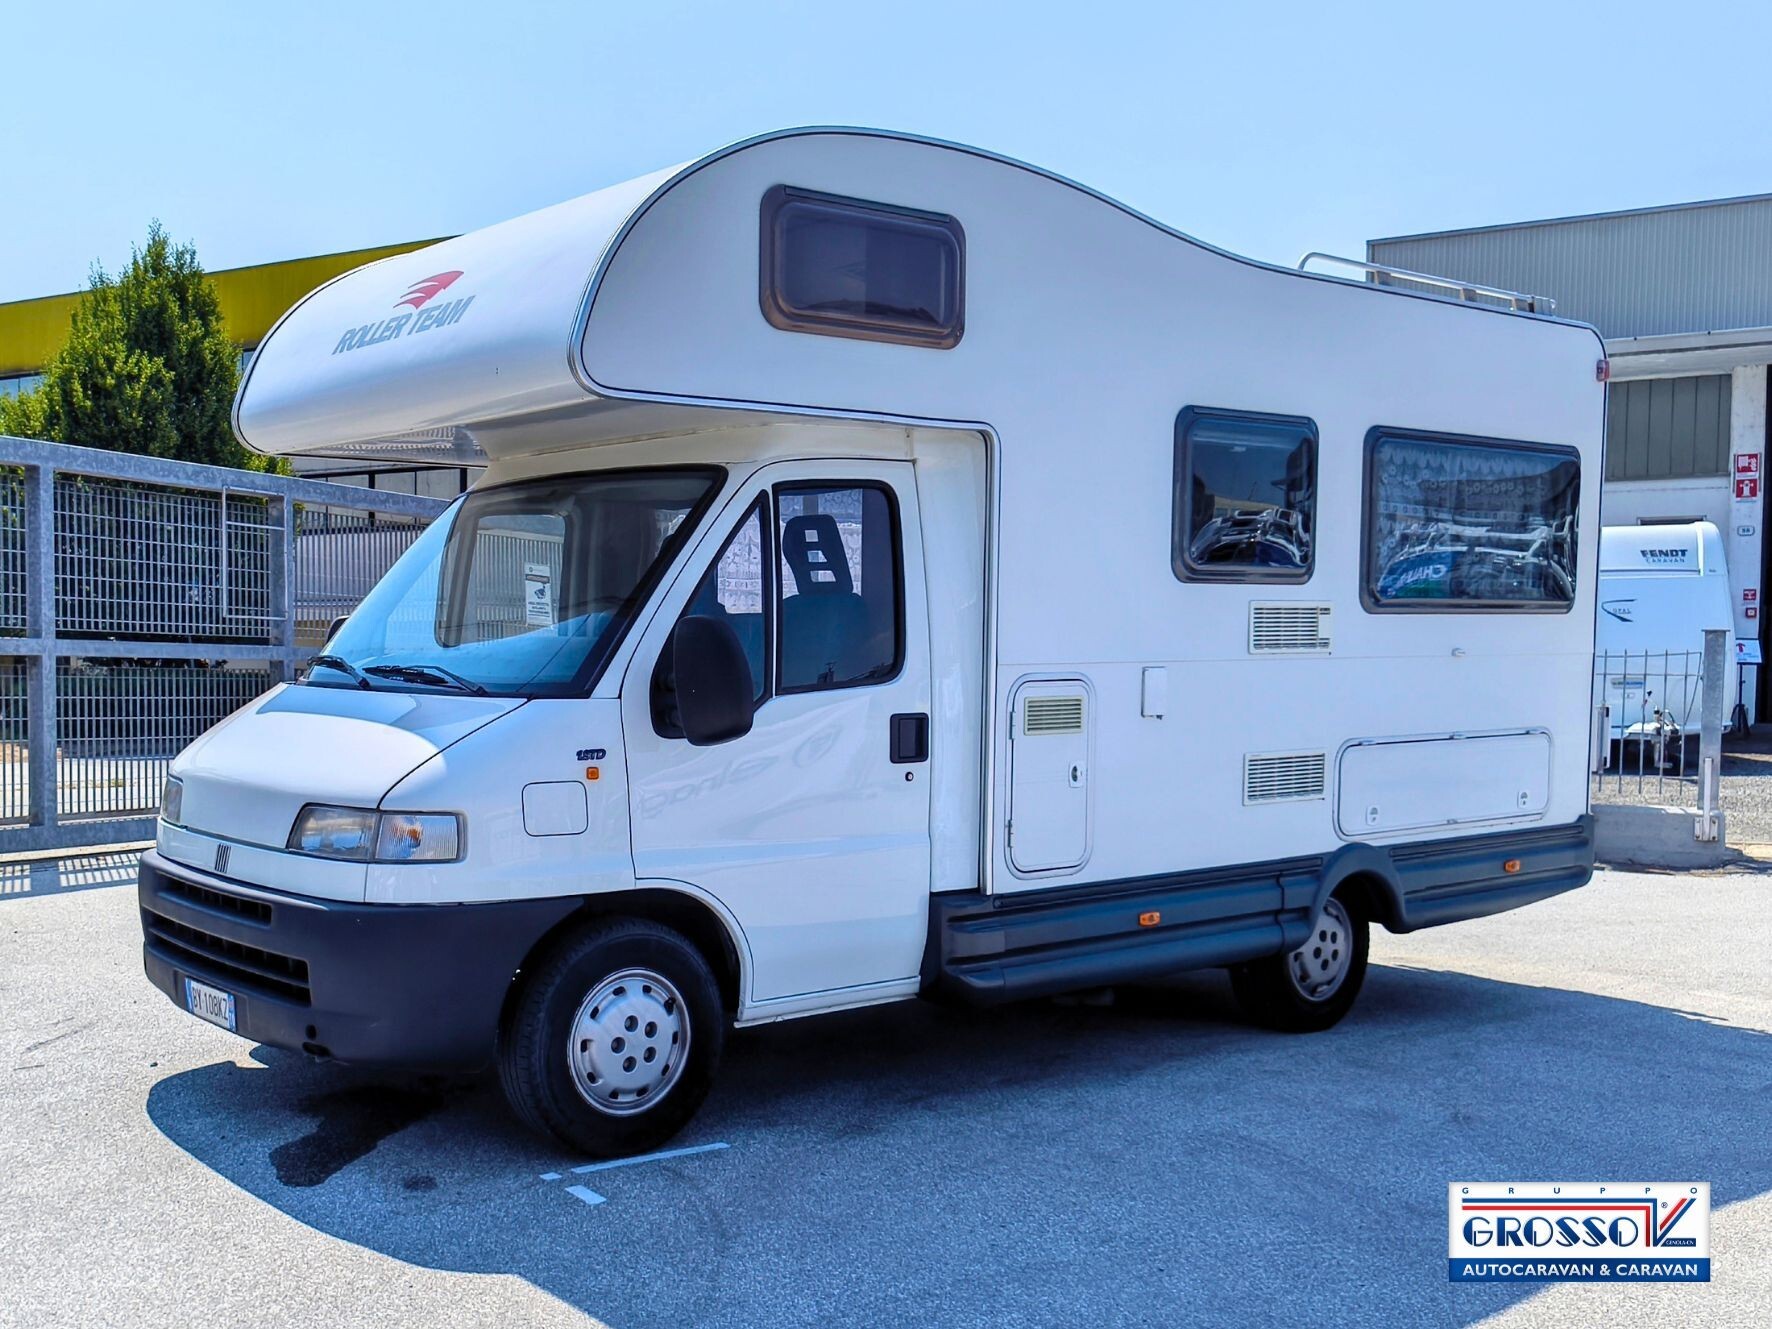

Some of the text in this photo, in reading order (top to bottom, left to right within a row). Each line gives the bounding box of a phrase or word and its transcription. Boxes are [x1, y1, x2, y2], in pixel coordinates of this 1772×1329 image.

[332, 294, 476, 355] ROLLER TEAM
[1640, 549, 1688, 557] FENDT
